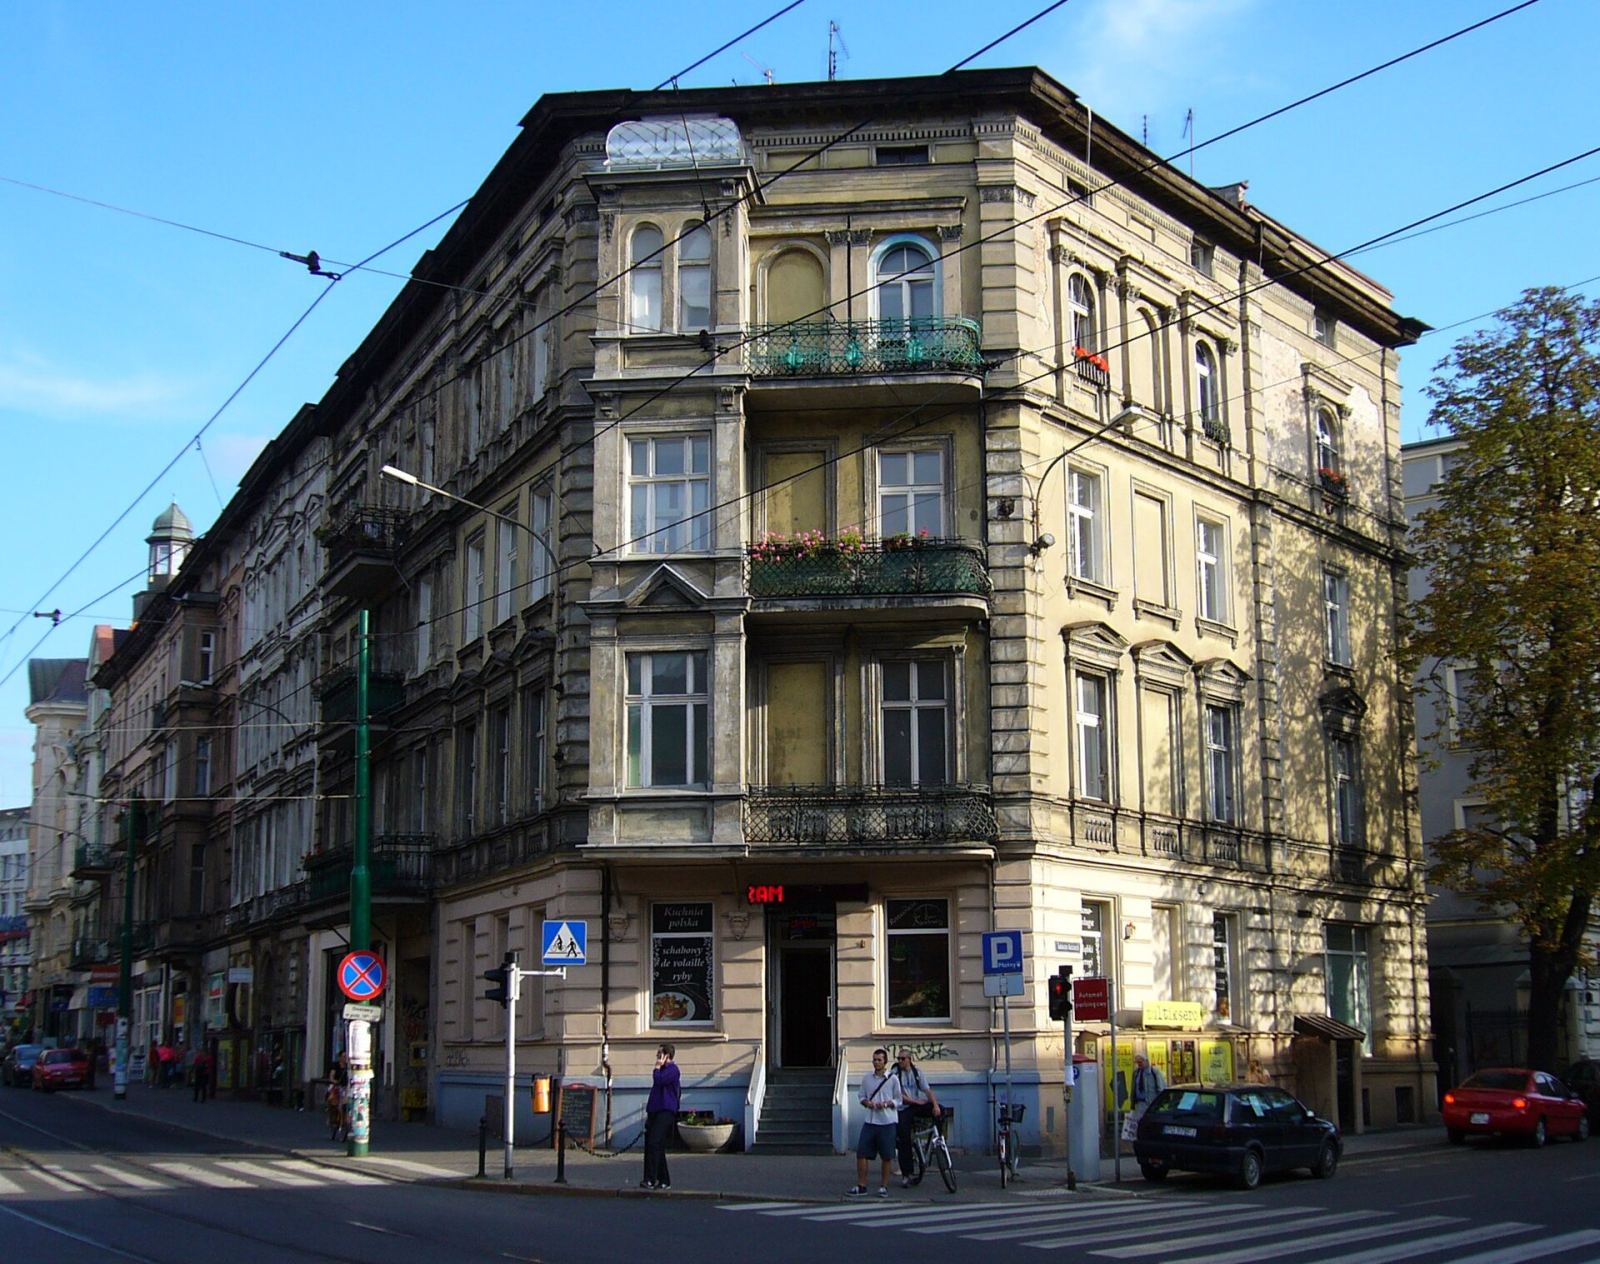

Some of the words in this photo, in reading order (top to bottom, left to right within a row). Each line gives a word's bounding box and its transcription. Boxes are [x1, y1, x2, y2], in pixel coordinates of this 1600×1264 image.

[664, 906, 704, 917] Kuchnia
[668, 918, 699, 930] polska
[662, 946, 704, 957] schabowy
[990, 936, 1013, 968] P
[660, 959, 671, 968] de
[673, 958, 705, 968] volaille
[672, 971, 693, 984] ryby
[1079, 991, 1103, 999] Automat
